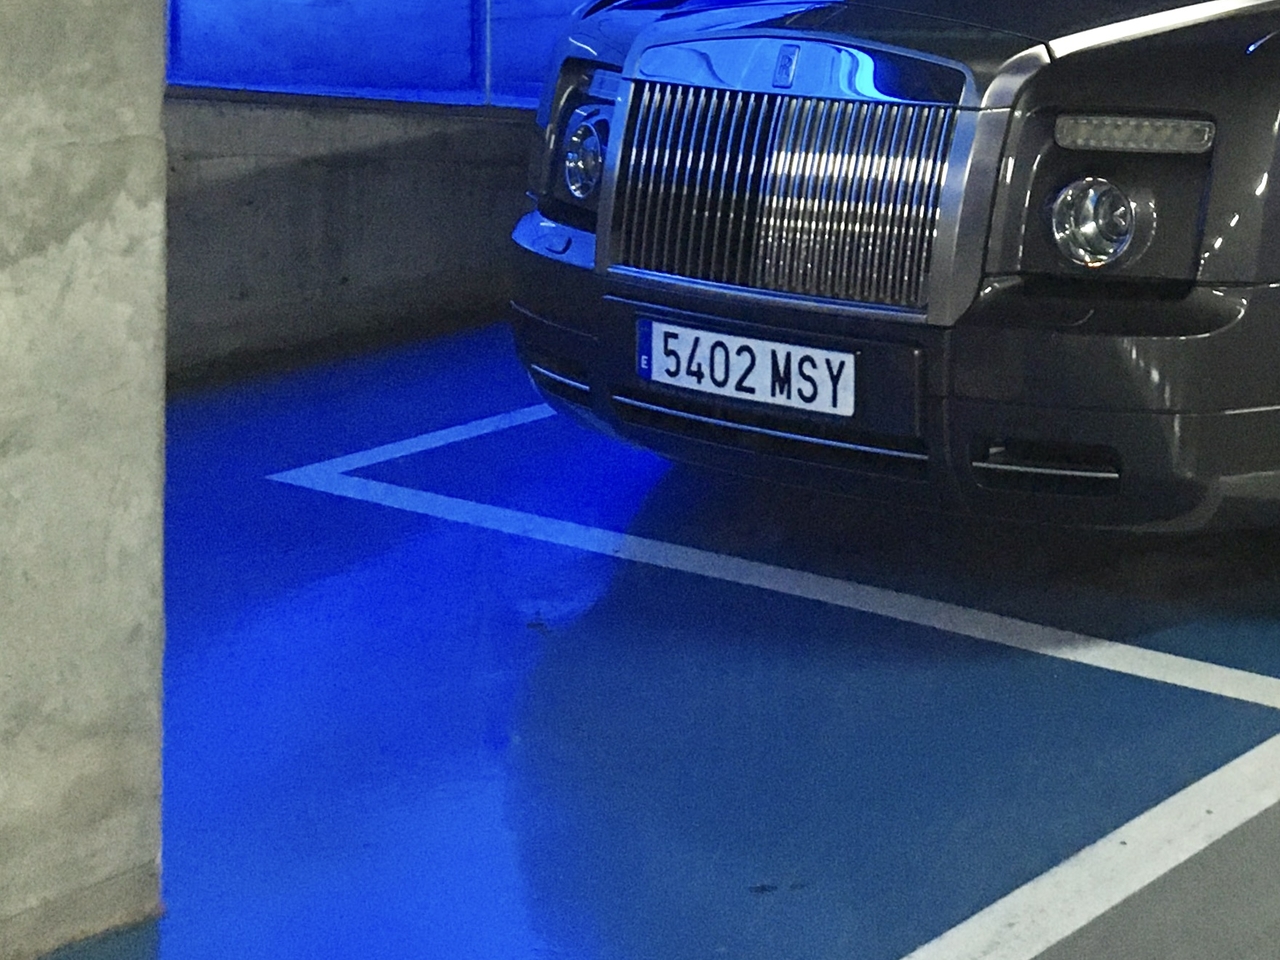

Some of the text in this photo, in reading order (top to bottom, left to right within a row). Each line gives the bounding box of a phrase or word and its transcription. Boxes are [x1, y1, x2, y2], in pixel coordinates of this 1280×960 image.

[641, 355, 649, 369] E
[663, 331, 846, 408] 5402 MSY
